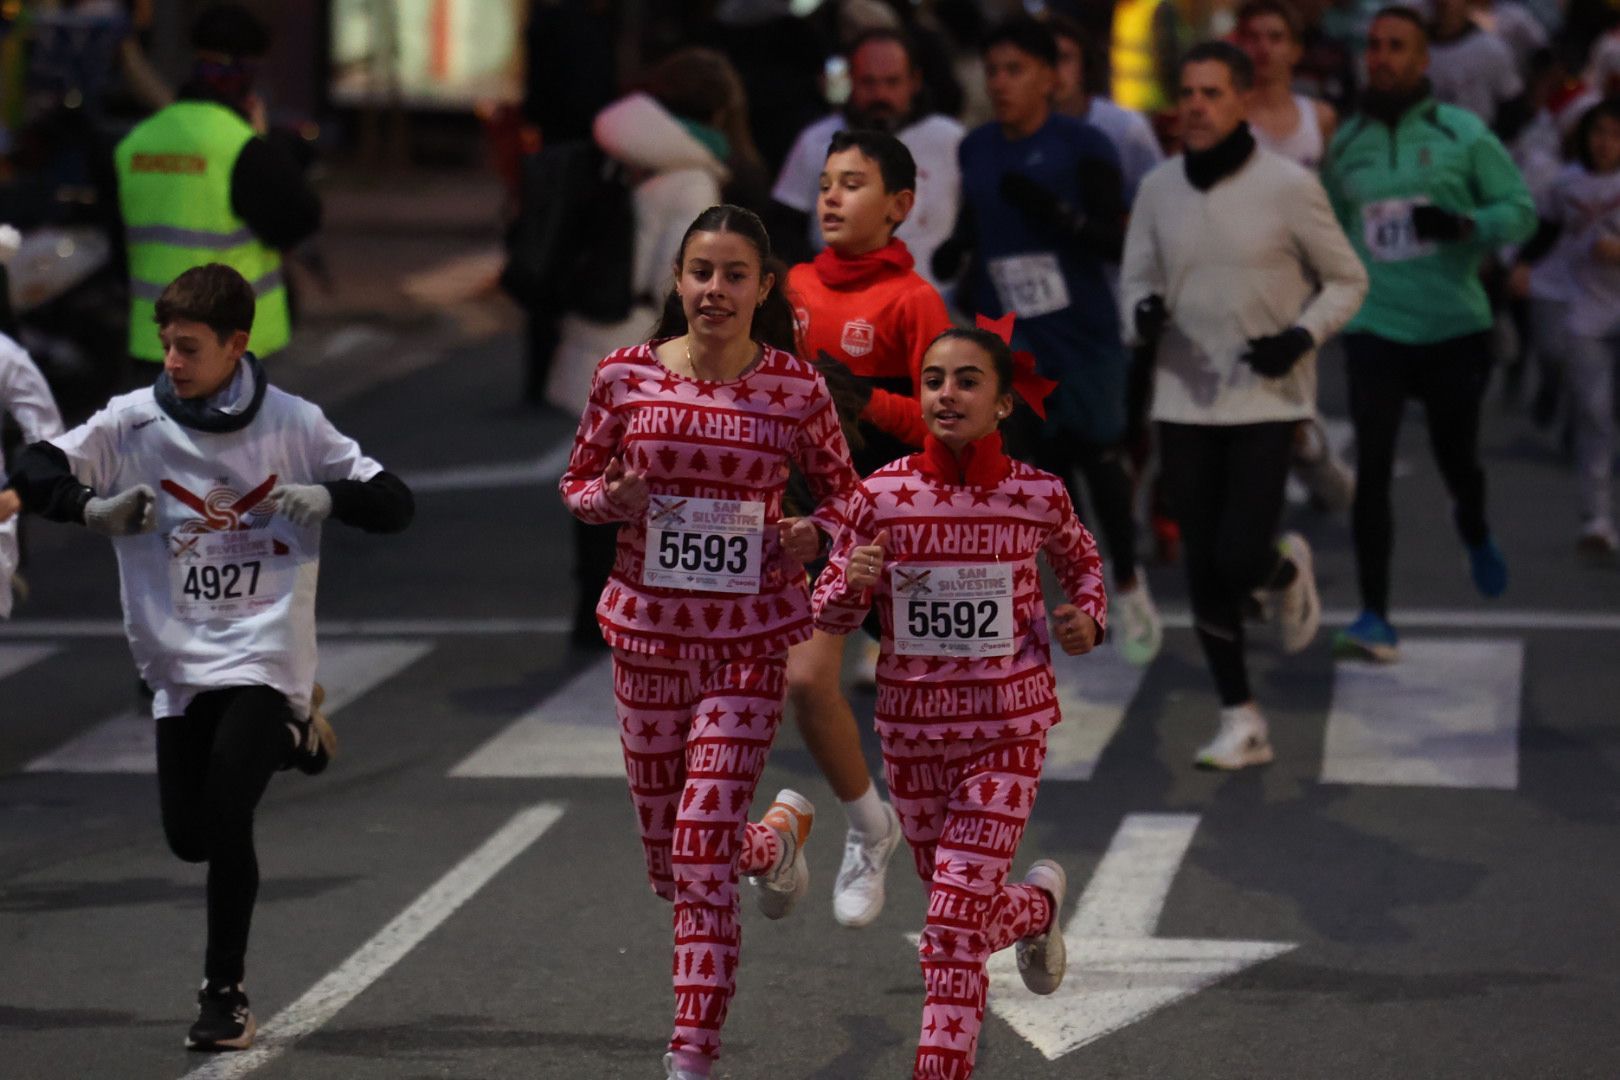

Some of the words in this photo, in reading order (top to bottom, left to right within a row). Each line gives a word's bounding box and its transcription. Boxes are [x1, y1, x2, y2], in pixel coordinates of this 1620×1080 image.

[626, 406, 688, 436] ERRY
[692, 511, 759, 526] SILVESTRE
[712, 501, 741, 513] SAN
[659, 531, 748, 574] 5593
[183, 561, 261, 600] 4927
[937, 577, 1007, 592] SILVESTRE
[958, 567, 987, 579] SAN
[909, 600, 999, 639] 5592
[995, 671, 1053, 714] MERR
